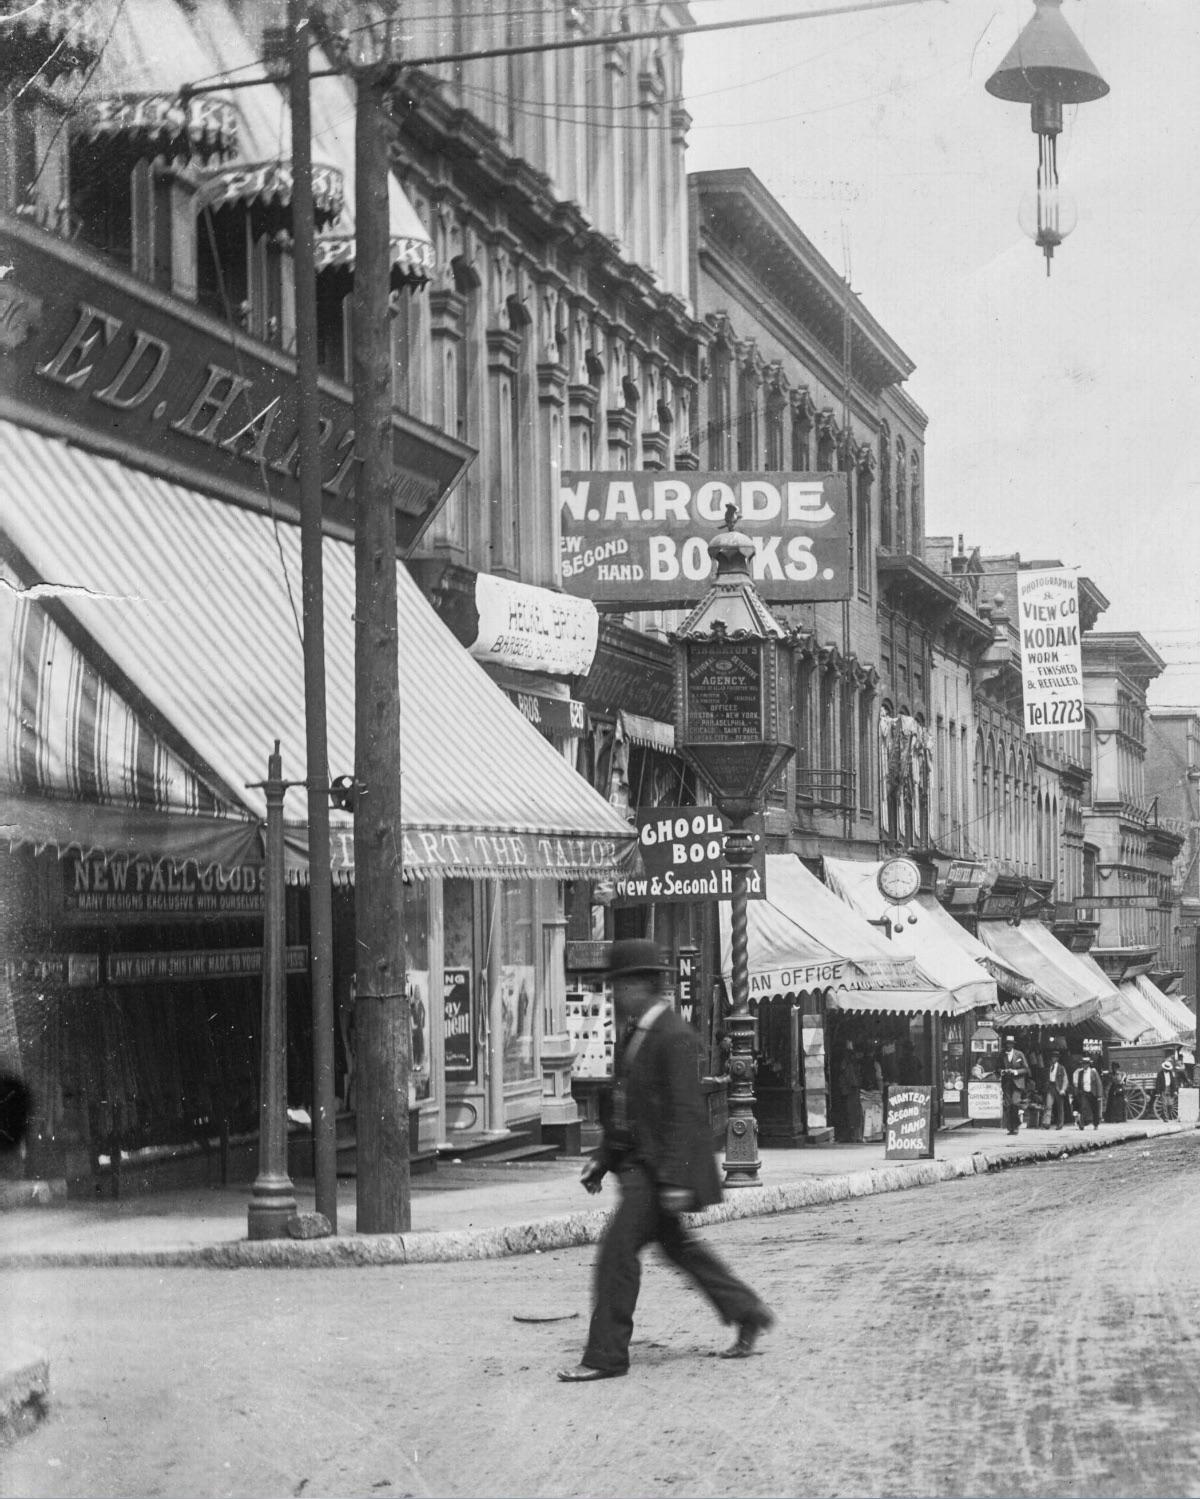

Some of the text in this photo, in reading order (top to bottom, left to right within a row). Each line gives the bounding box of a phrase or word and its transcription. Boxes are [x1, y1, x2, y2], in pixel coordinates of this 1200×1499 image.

[562, 538, 629, 577] SECOND
[649, 535, 835, 582] BOKS.
[597, 564, 644, 581] HAND
[1023, 601, 1057, 621] VIEW
[1023, 625, 1078, 649] KODAK
[1028, 651, 1059, 664] WORK
[1037, 664, 1078, 676] FINISHED
[640, 812, 723, 847] CHOOL
[474, 834, 527, 866] THE
[537, 837, 617, 868] TAILOR
[74, 860, 130, 891] NEW
[135, 859, 196, 892] FALL
[651, 876, 662, 896] &
[780, 964, 843, 986] OFFICE
[888, 1091, 930, 1106] WANTED!
[900, 1117, 926, 1135] HAND
